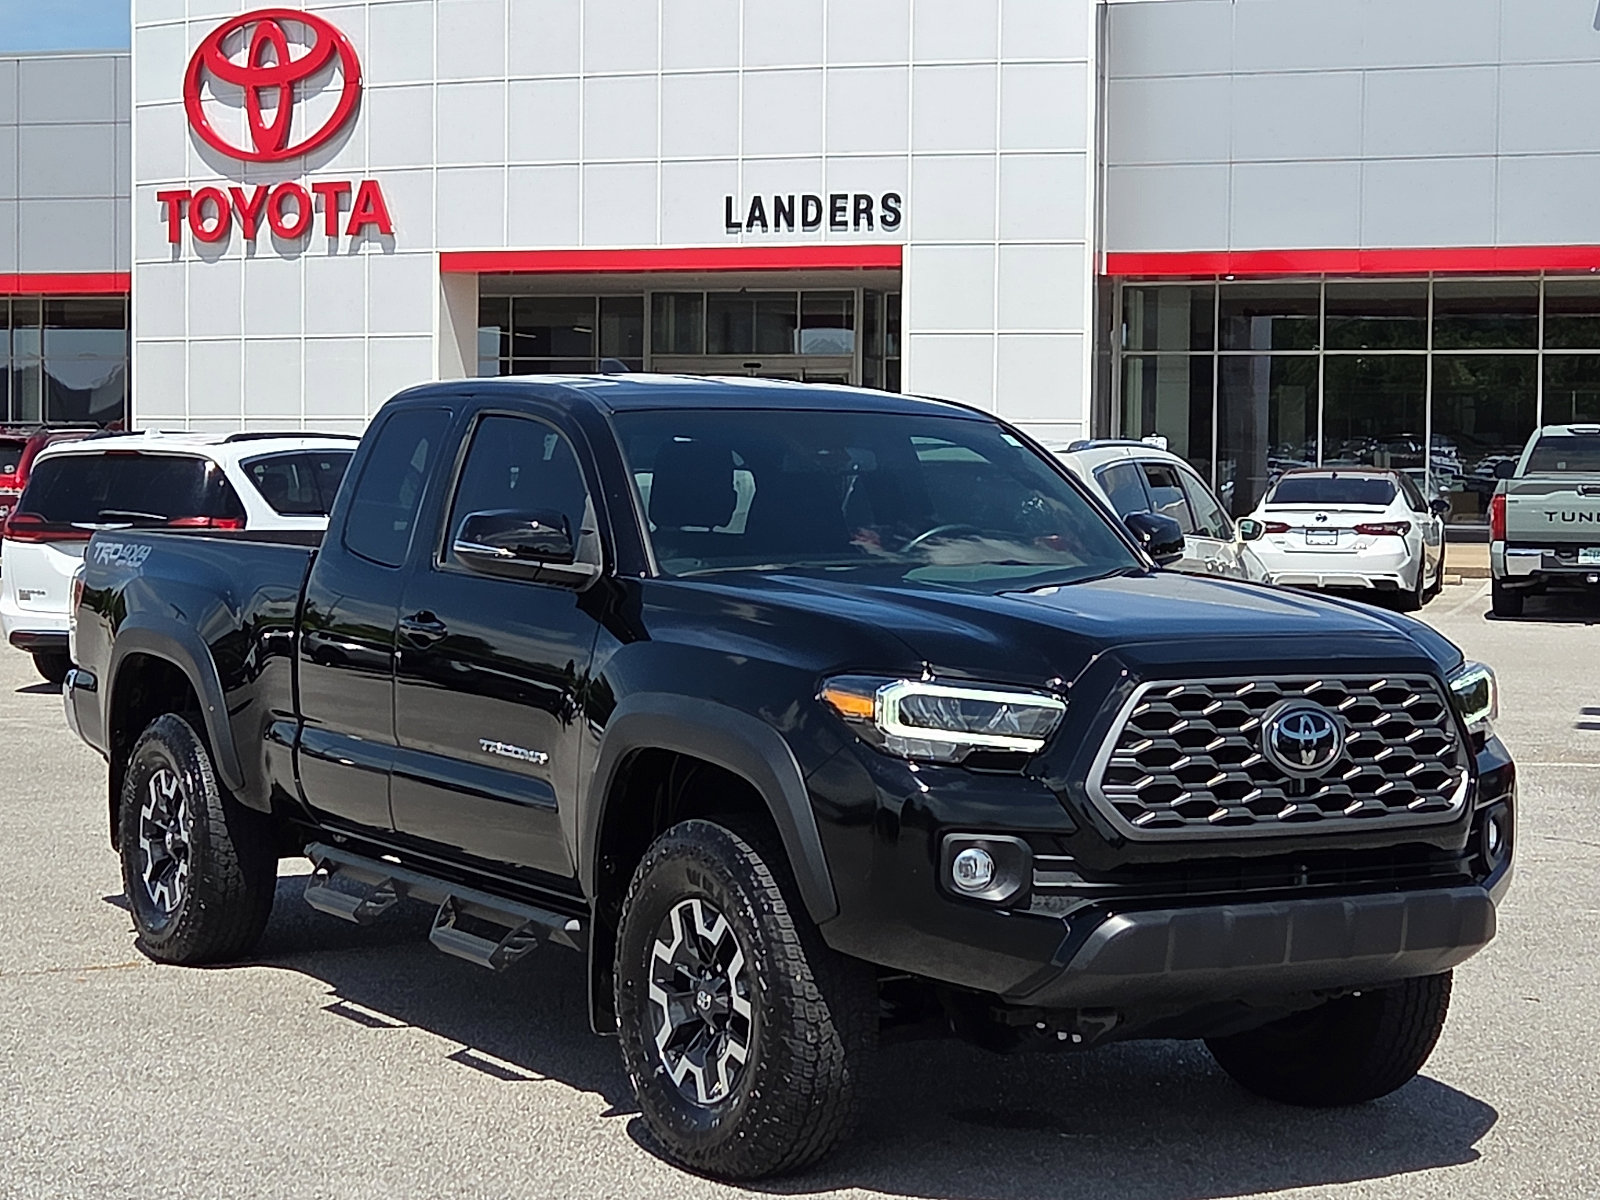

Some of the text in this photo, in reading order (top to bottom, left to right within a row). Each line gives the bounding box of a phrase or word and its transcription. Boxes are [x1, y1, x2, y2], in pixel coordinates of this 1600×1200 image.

[157, 180, 394, 243] TOYOTA
[725, 193, 902, 230] LANDERS
[1544, 511, 1600, 522] TUN
